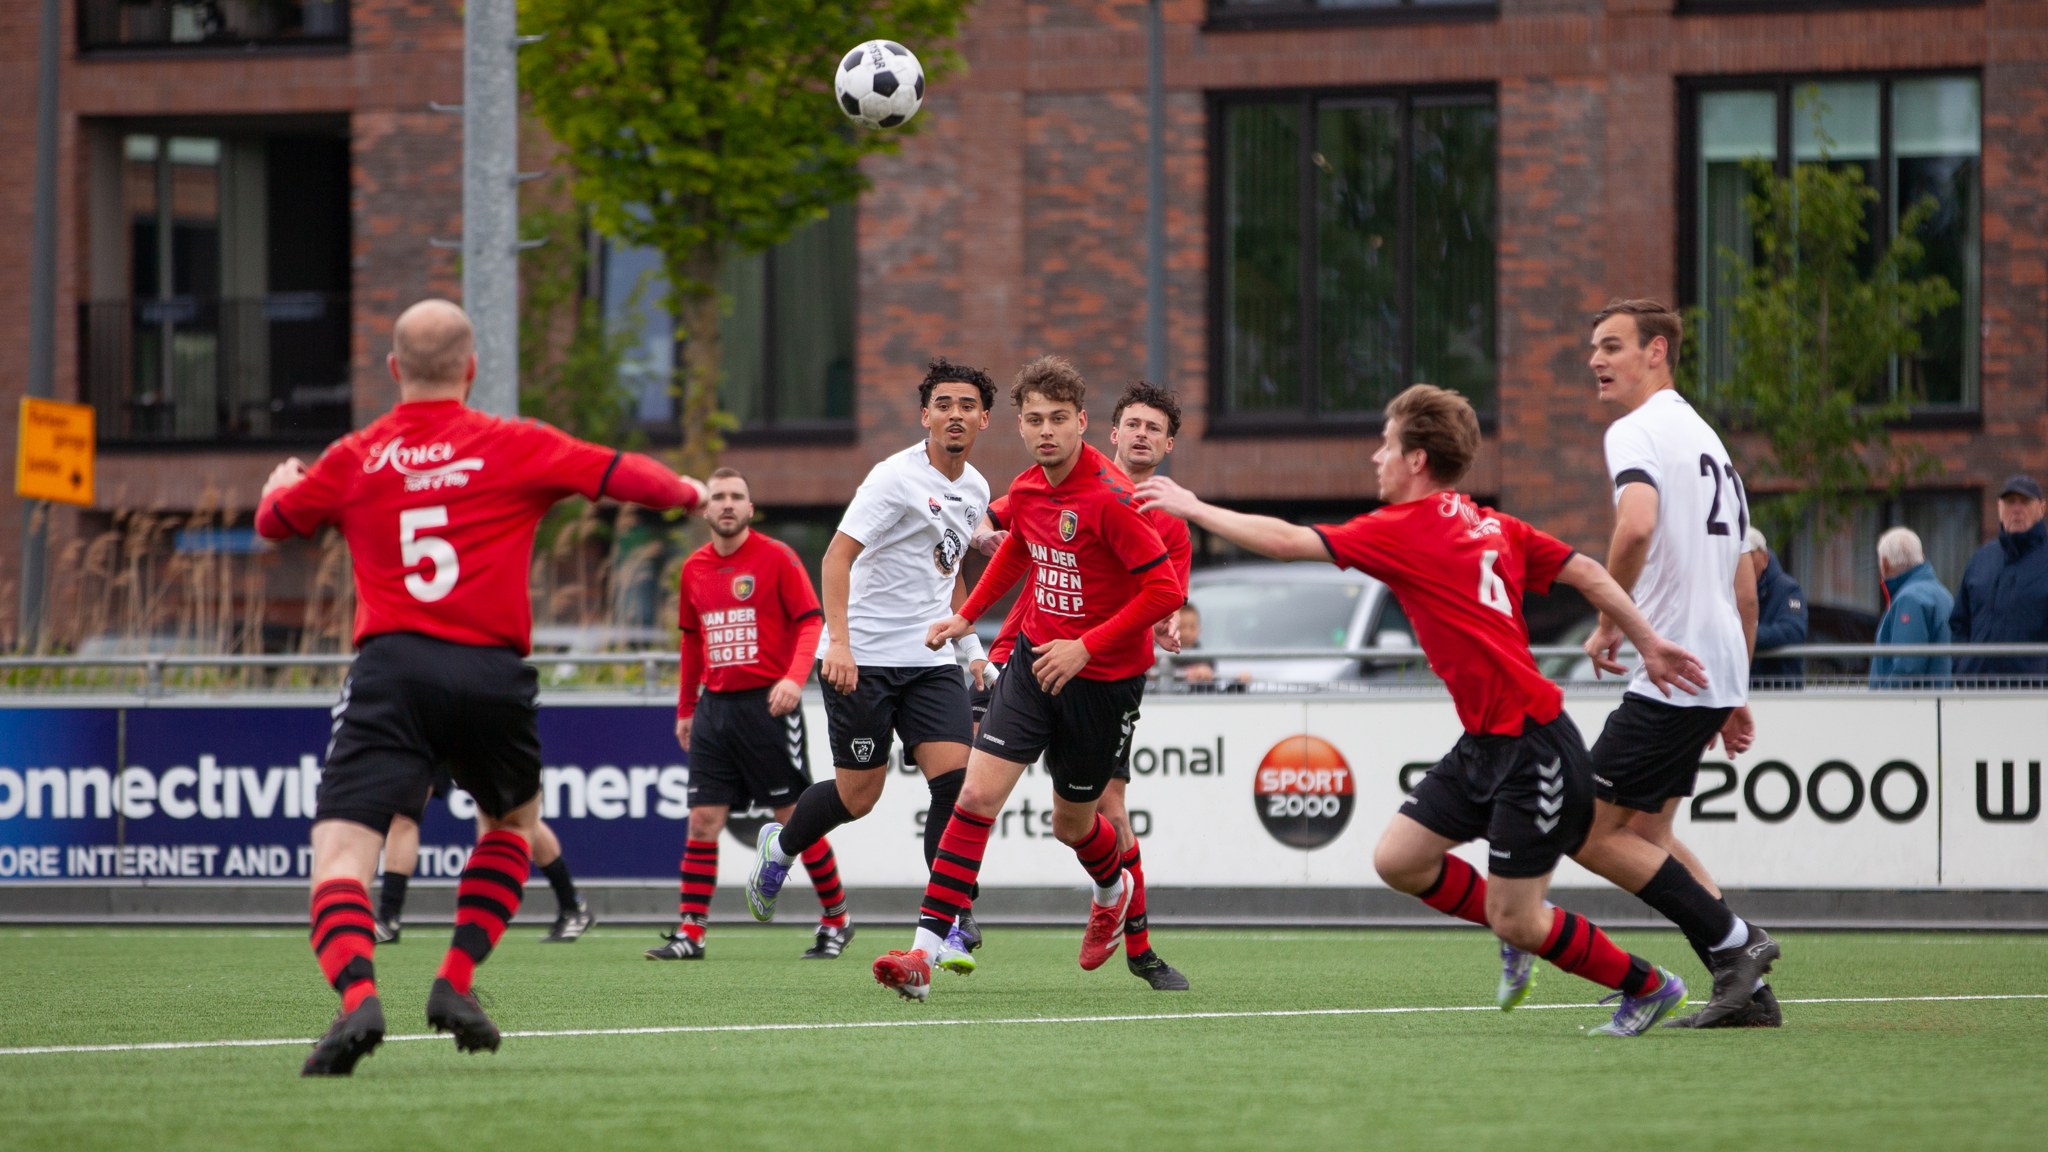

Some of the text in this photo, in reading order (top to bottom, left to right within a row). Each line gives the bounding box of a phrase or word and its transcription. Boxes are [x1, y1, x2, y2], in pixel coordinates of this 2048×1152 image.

[400, 505, 459, 602] 5
[1051, 548, 1077, 567] DER
[1037, 566, 1082, 590] NDEN
[728, 608, 756, 623] DER
[708, 627, 757, 645] INDEN
[0, 754, 320, 819] onnectivit
[1260, 767, 1348, 791] SPORT
[1690, 759, 1929, 823] 2000
[1268, 795, 1340, 817] 2000
[0, 846, 60, 876] ORE
[67, 846, 218, 876] INTERNET
[224, 846, 291, 876] AND
